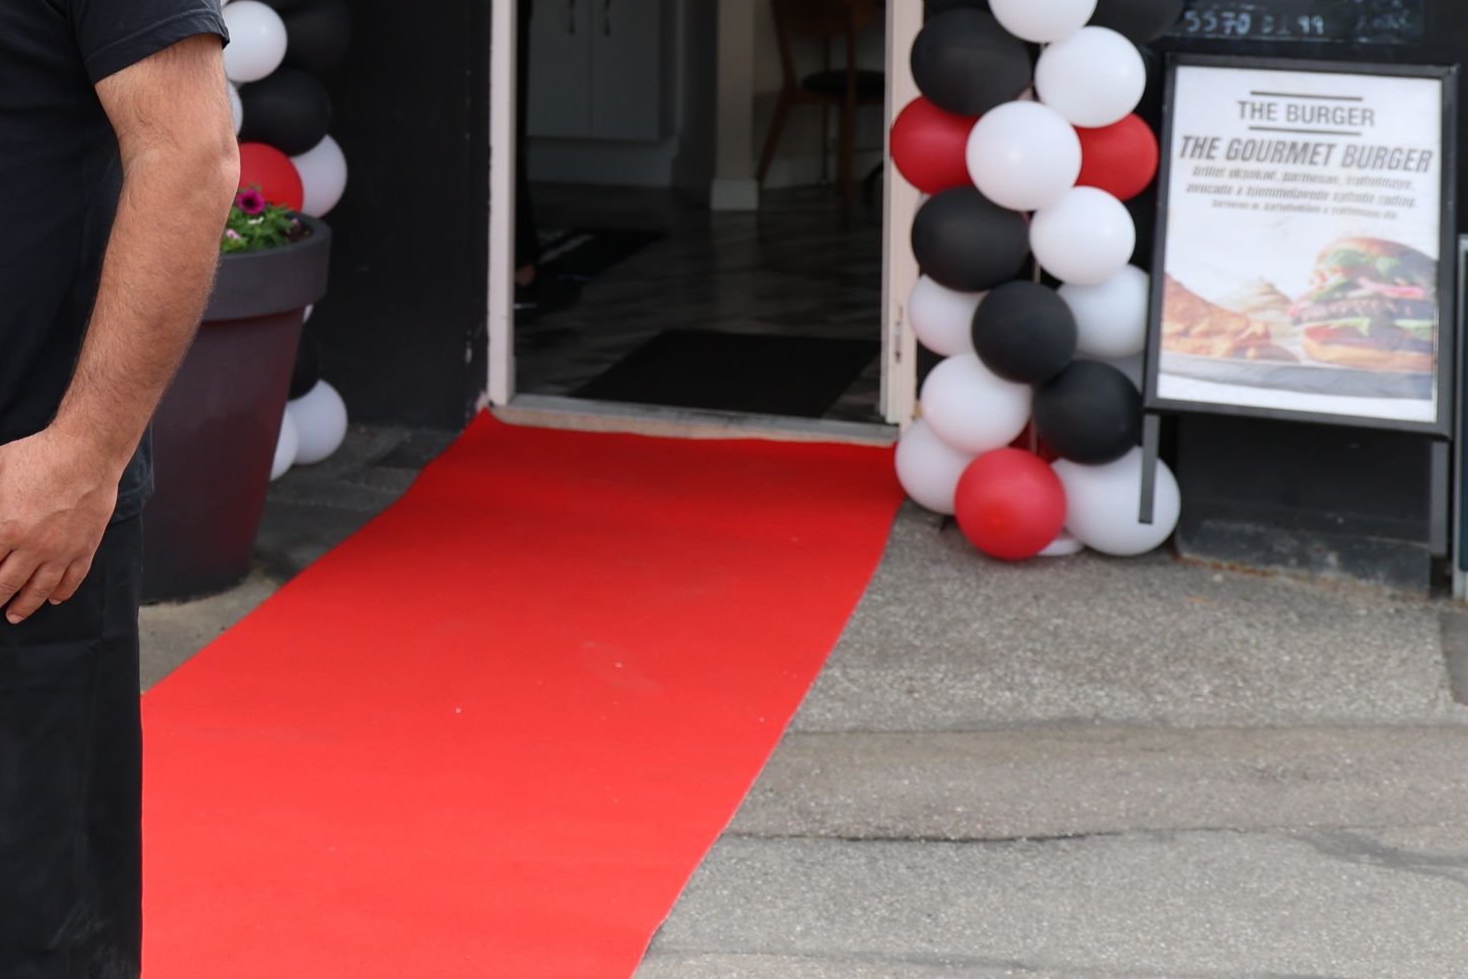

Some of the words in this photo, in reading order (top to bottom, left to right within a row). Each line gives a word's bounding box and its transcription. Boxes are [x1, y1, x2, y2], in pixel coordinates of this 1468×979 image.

[1237, 100, 1278, 122] THE
[1286, 103, 1375, 128] BURGER
[1179, 135, 1220, 160] THE
[1226, 137, 1337, 166] GOURMET
[1341, 144, 1433, 173] BURGER
